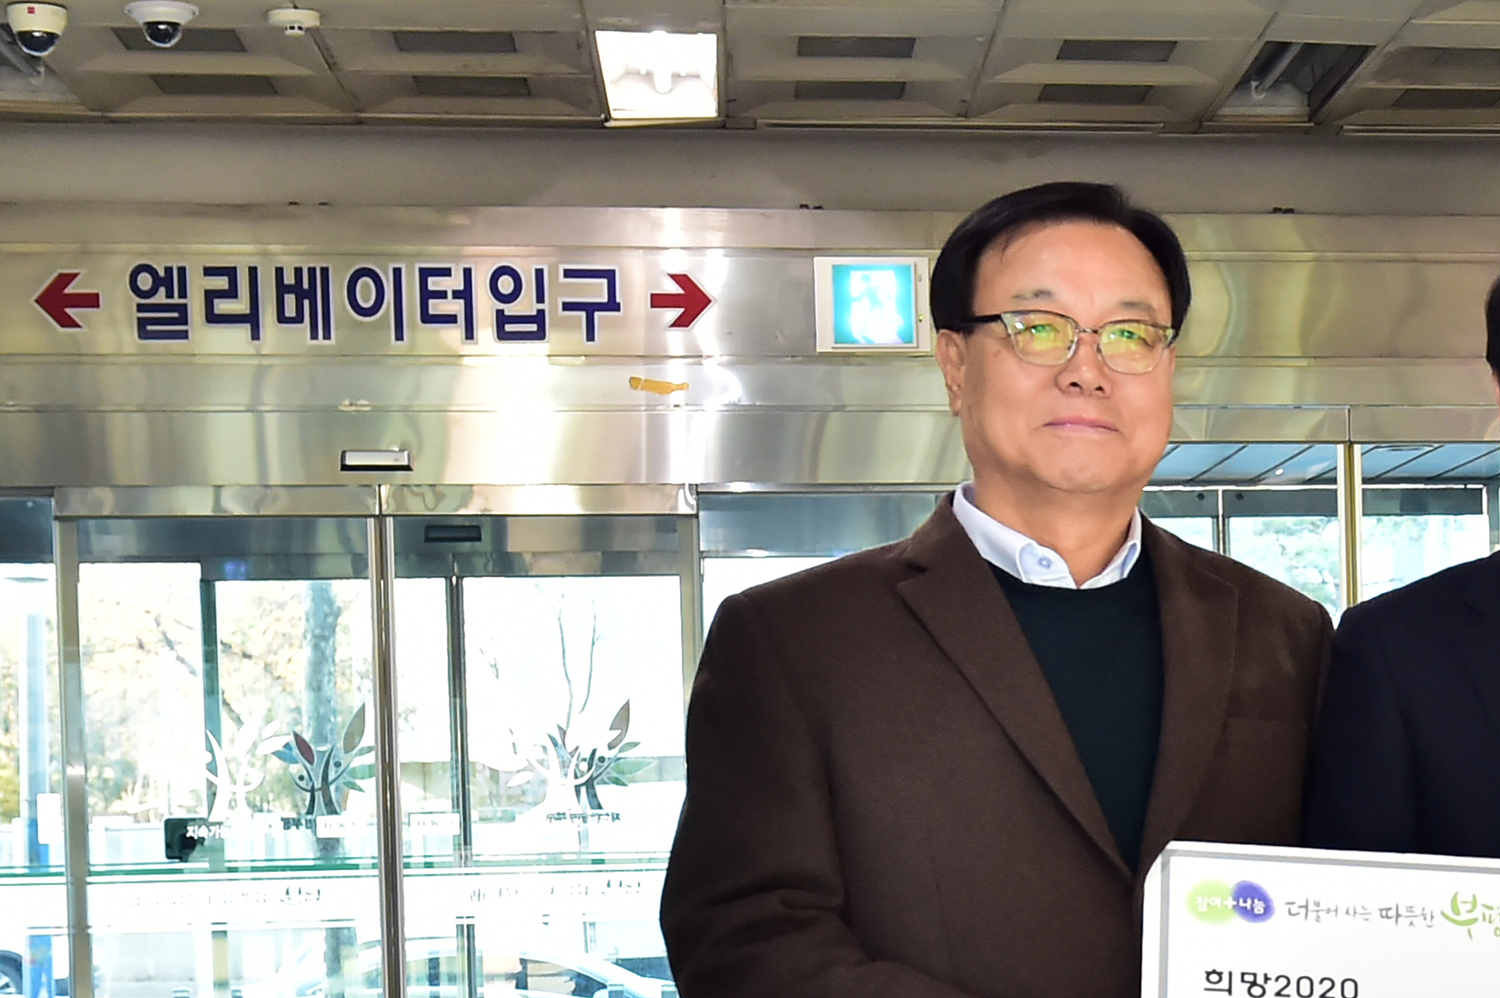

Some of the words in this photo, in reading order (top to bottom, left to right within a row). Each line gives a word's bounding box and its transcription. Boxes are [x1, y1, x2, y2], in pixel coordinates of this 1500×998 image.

[128, 263, 622, 343] 엘리베이터입구
[1284, 898, 1339, 923] 더불어
[1344, 904, 1373, 921] 사는
[1378, 903, 1435, 928] 따뜻한
